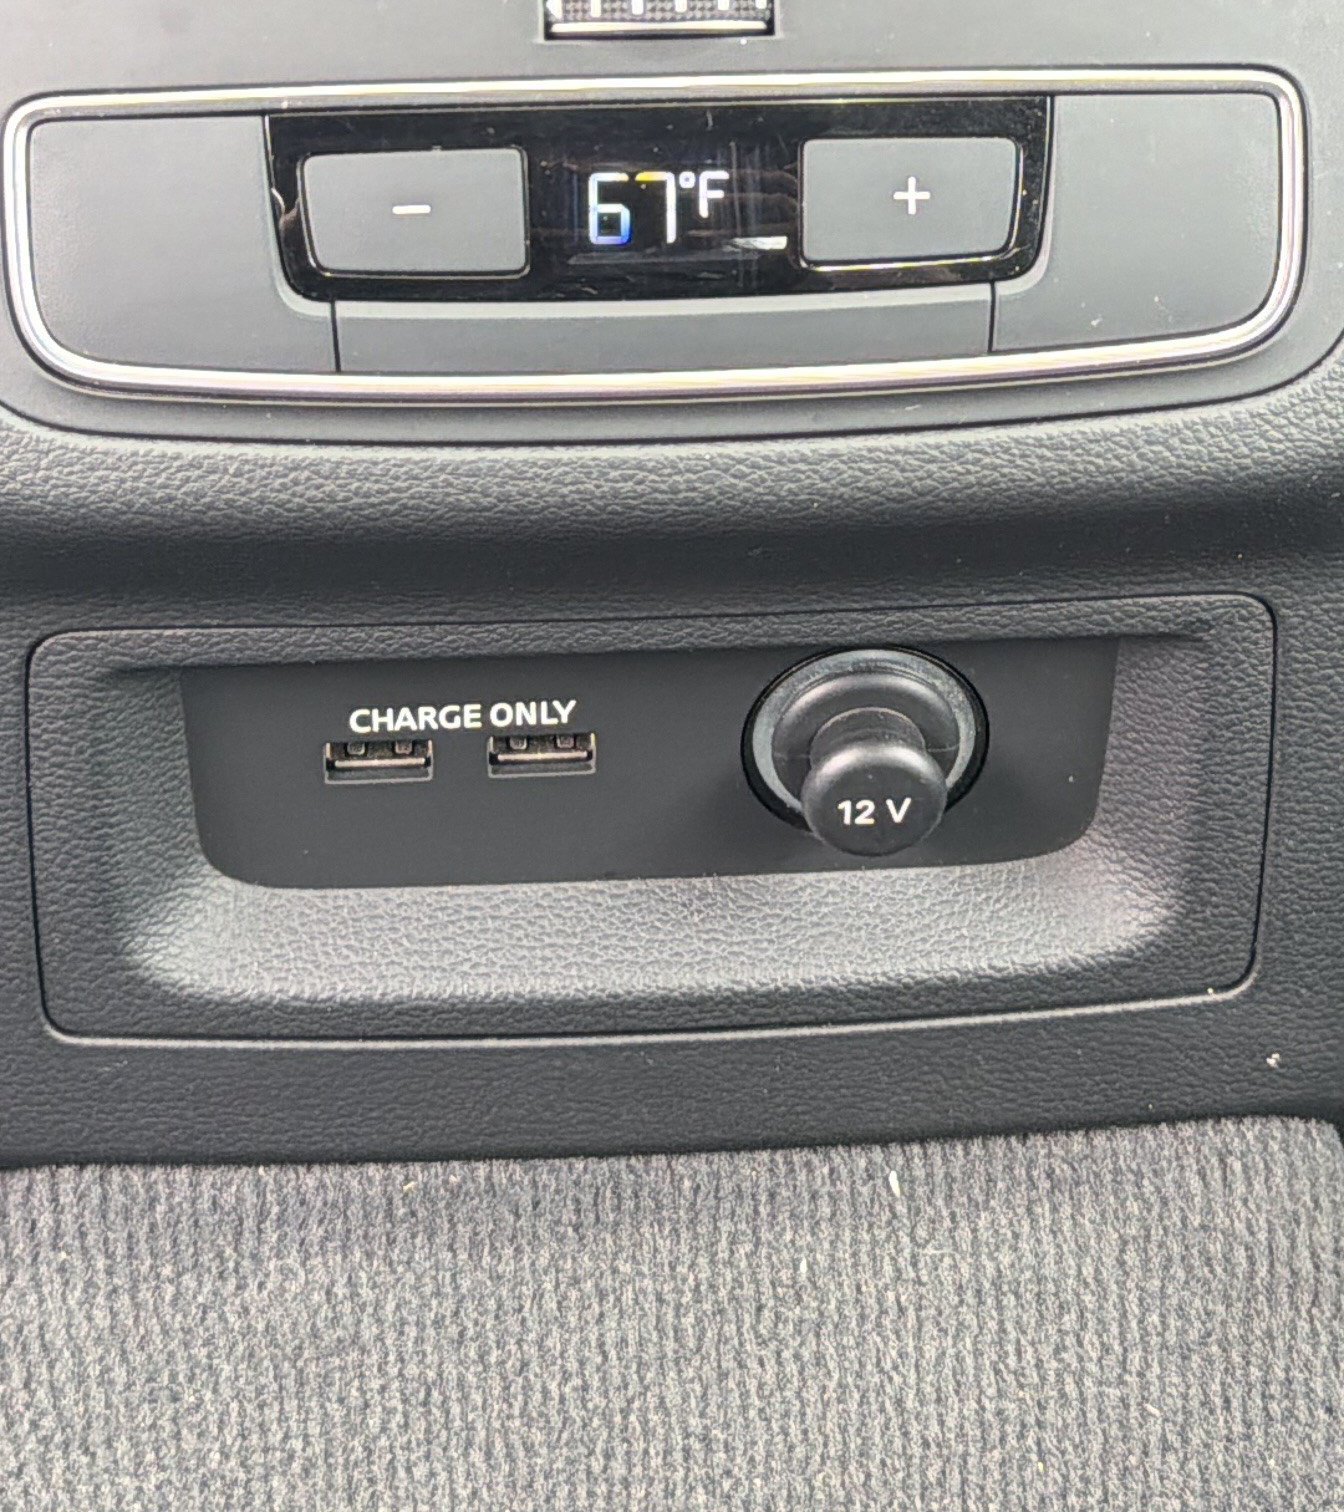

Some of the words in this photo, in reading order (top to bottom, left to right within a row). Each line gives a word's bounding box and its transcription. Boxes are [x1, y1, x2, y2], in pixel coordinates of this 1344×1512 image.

[348, 703, 483, 734] CHARGE
[489, 699, 577, 729] ONLY
[837, 799, 876, 826] 12
[885, 797, 912, 824] V
